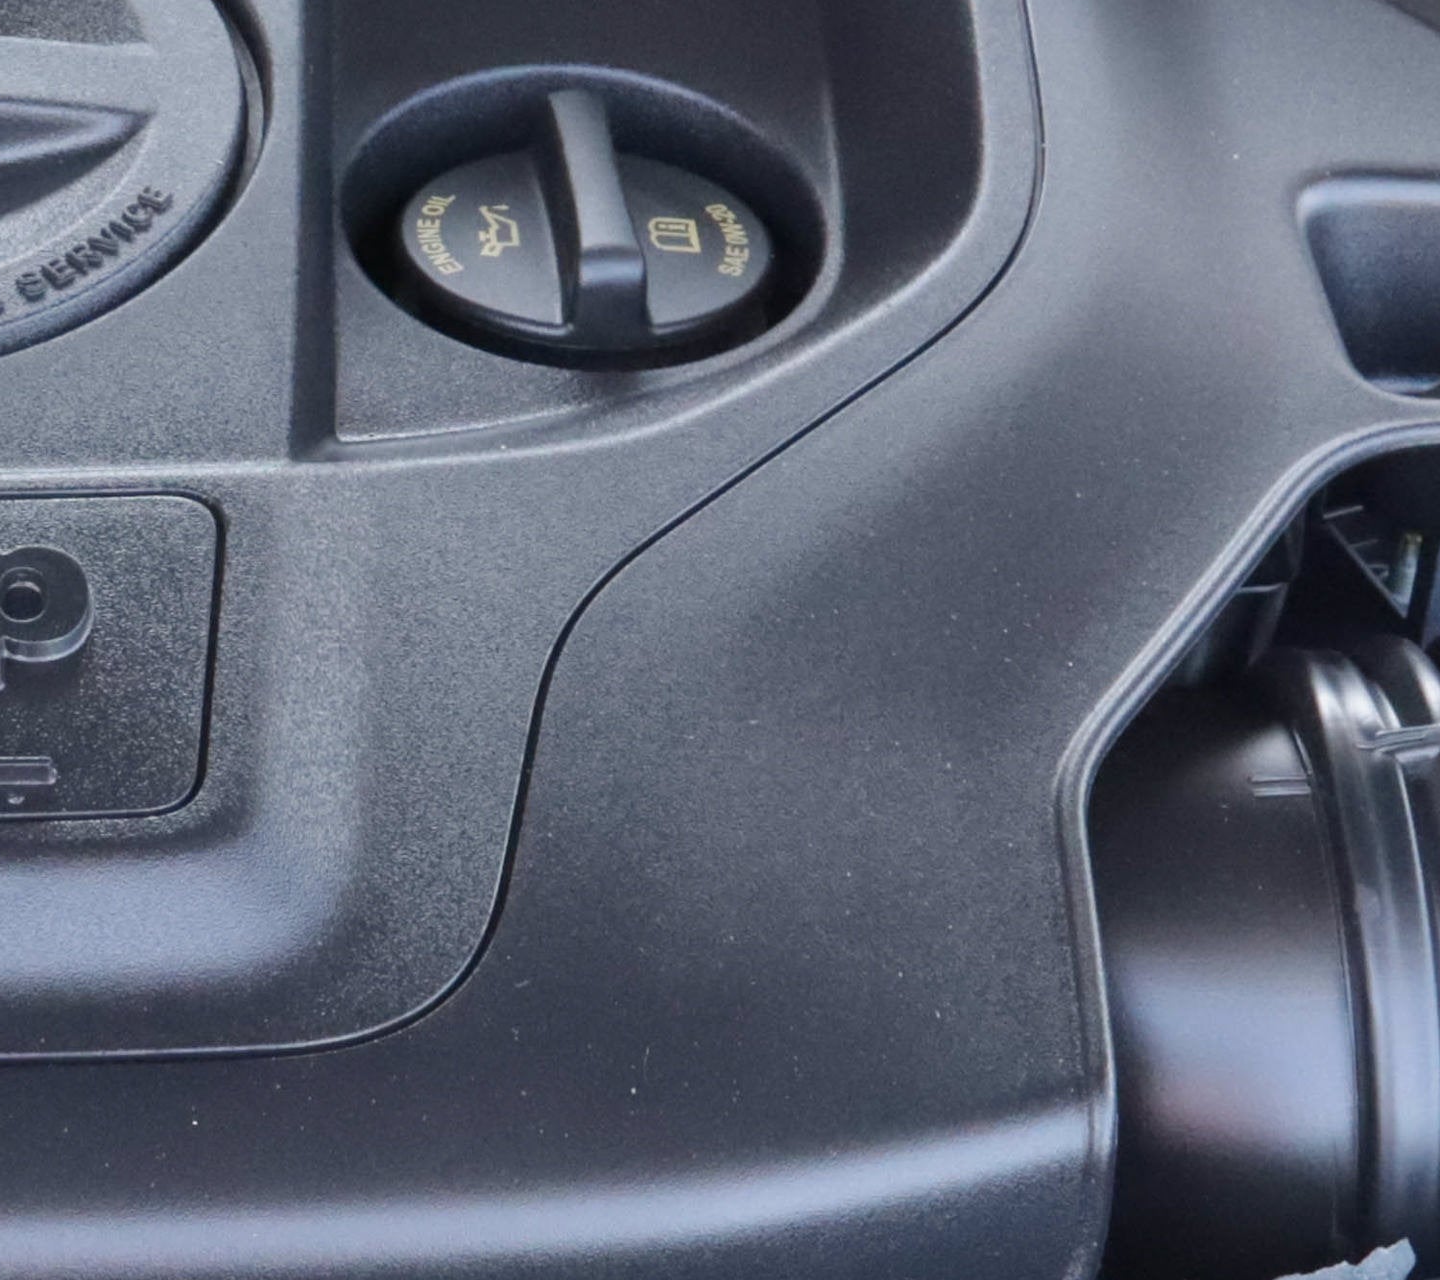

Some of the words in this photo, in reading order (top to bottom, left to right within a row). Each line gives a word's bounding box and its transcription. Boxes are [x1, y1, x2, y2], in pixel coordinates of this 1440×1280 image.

[421, 194, 456, 217] OIL
[16, 186, 171, 303] SERVICE
[416, 219, 464, 275] ENGINE
[718, 246, 750, 276] SAE
